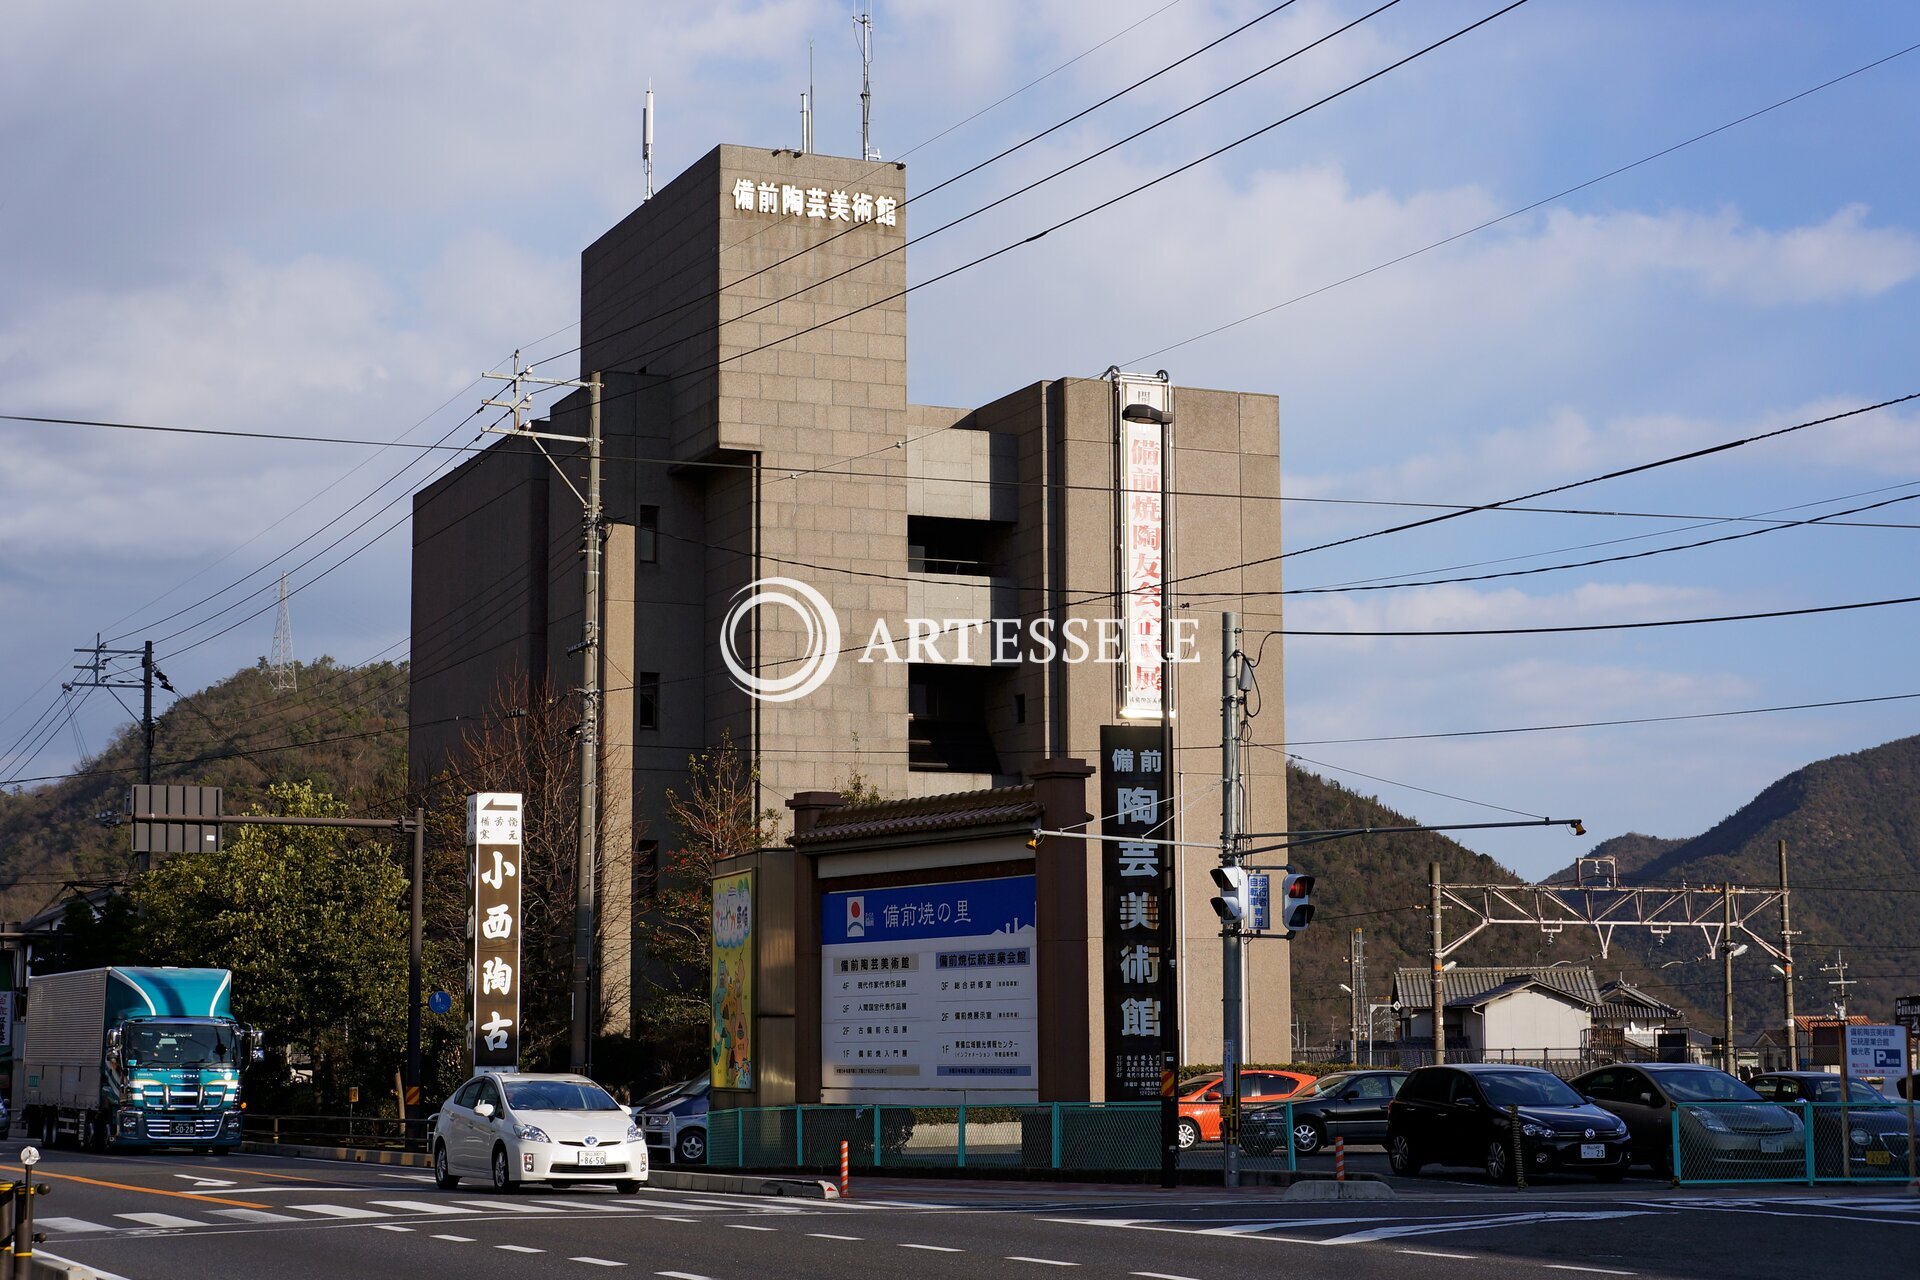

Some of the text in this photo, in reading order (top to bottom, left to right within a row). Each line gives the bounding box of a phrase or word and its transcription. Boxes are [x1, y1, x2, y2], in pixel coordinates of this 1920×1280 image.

[732, 178, 897, 227] 備前陶芸美術館
[1112, 748, 1162, 773] 備前
[1250, 877, 1259, 906] 自転車
[1258, 877, 1267, 907] 歩行者
[883, 899, 971, 928] 備前焼の里
[1117, 786, 1161, 1038] 陶芸美術館
[1254, 907, 1263, 926] 専用
[481, 850, 516, 1052] 小西陶古
[841, 957, 910, 972] 備前陶芸美術館
[939, 951, 1027, 968] 備前焼伝統産業会館
[842, 980, 907, 990] 4F 現代作家代表作品展
[941, 981, 948, 990] 3F
[954, 980, 992, 989] 総合研修室
[842, 1002, 907, 1013] 3F 人間国宝代表作品展
[942, 1012, 949, 1021] 2F
[954, 1011, 992, 1020] 備前焼展示室
[842, 1025, 908, 1035] 2F 古備前名品展
[1850, 1027, 1896, 1037] 備前陶芸美術館
[942, 1040, 1019, 1054] 1F 東備広域観光情報センター
[1851, 1037, 1890, 1046] 伝統産業会館
[843, 1049, 908, 1058] 1F 備前焼入門展
[1851, 1047, 1871, 1056] 観光客
[1875, 1050, 1887, 1064] P
[584, 1157, 605, 1165] 86-50
